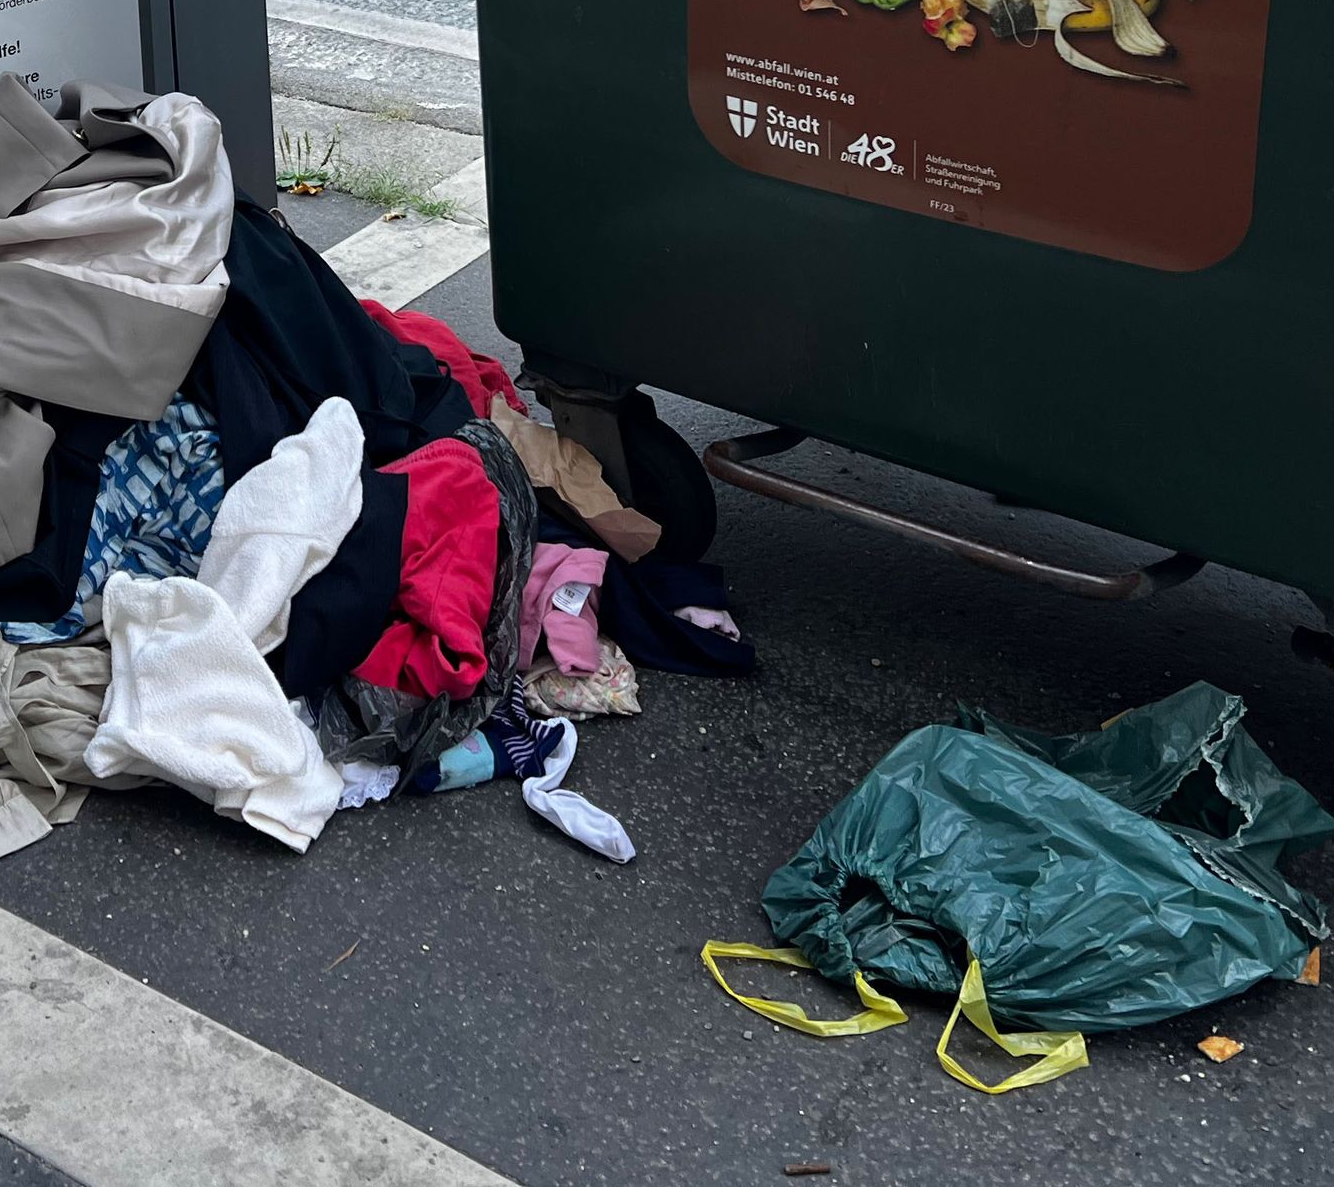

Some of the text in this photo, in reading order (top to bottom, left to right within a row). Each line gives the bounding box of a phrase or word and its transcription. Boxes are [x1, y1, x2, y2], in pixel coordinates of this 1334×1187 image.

[725, 52, 840, 86] www.abfall.wien.at
[725, 66, 856, 106] Misttelefon: 01 546 48
[765, 105, 820, 136] Stadt
[766, 125, 820, 157] Wien
[847, 132, 896, 172] 48
[924, 164, 1001, 191] Straßenreinigung
[925, 153, 998, 178] Abfallwirtschaft,
[925, 176, 984, 196] und Fuhrpark
[929, 199, 955, 213] FF/23
